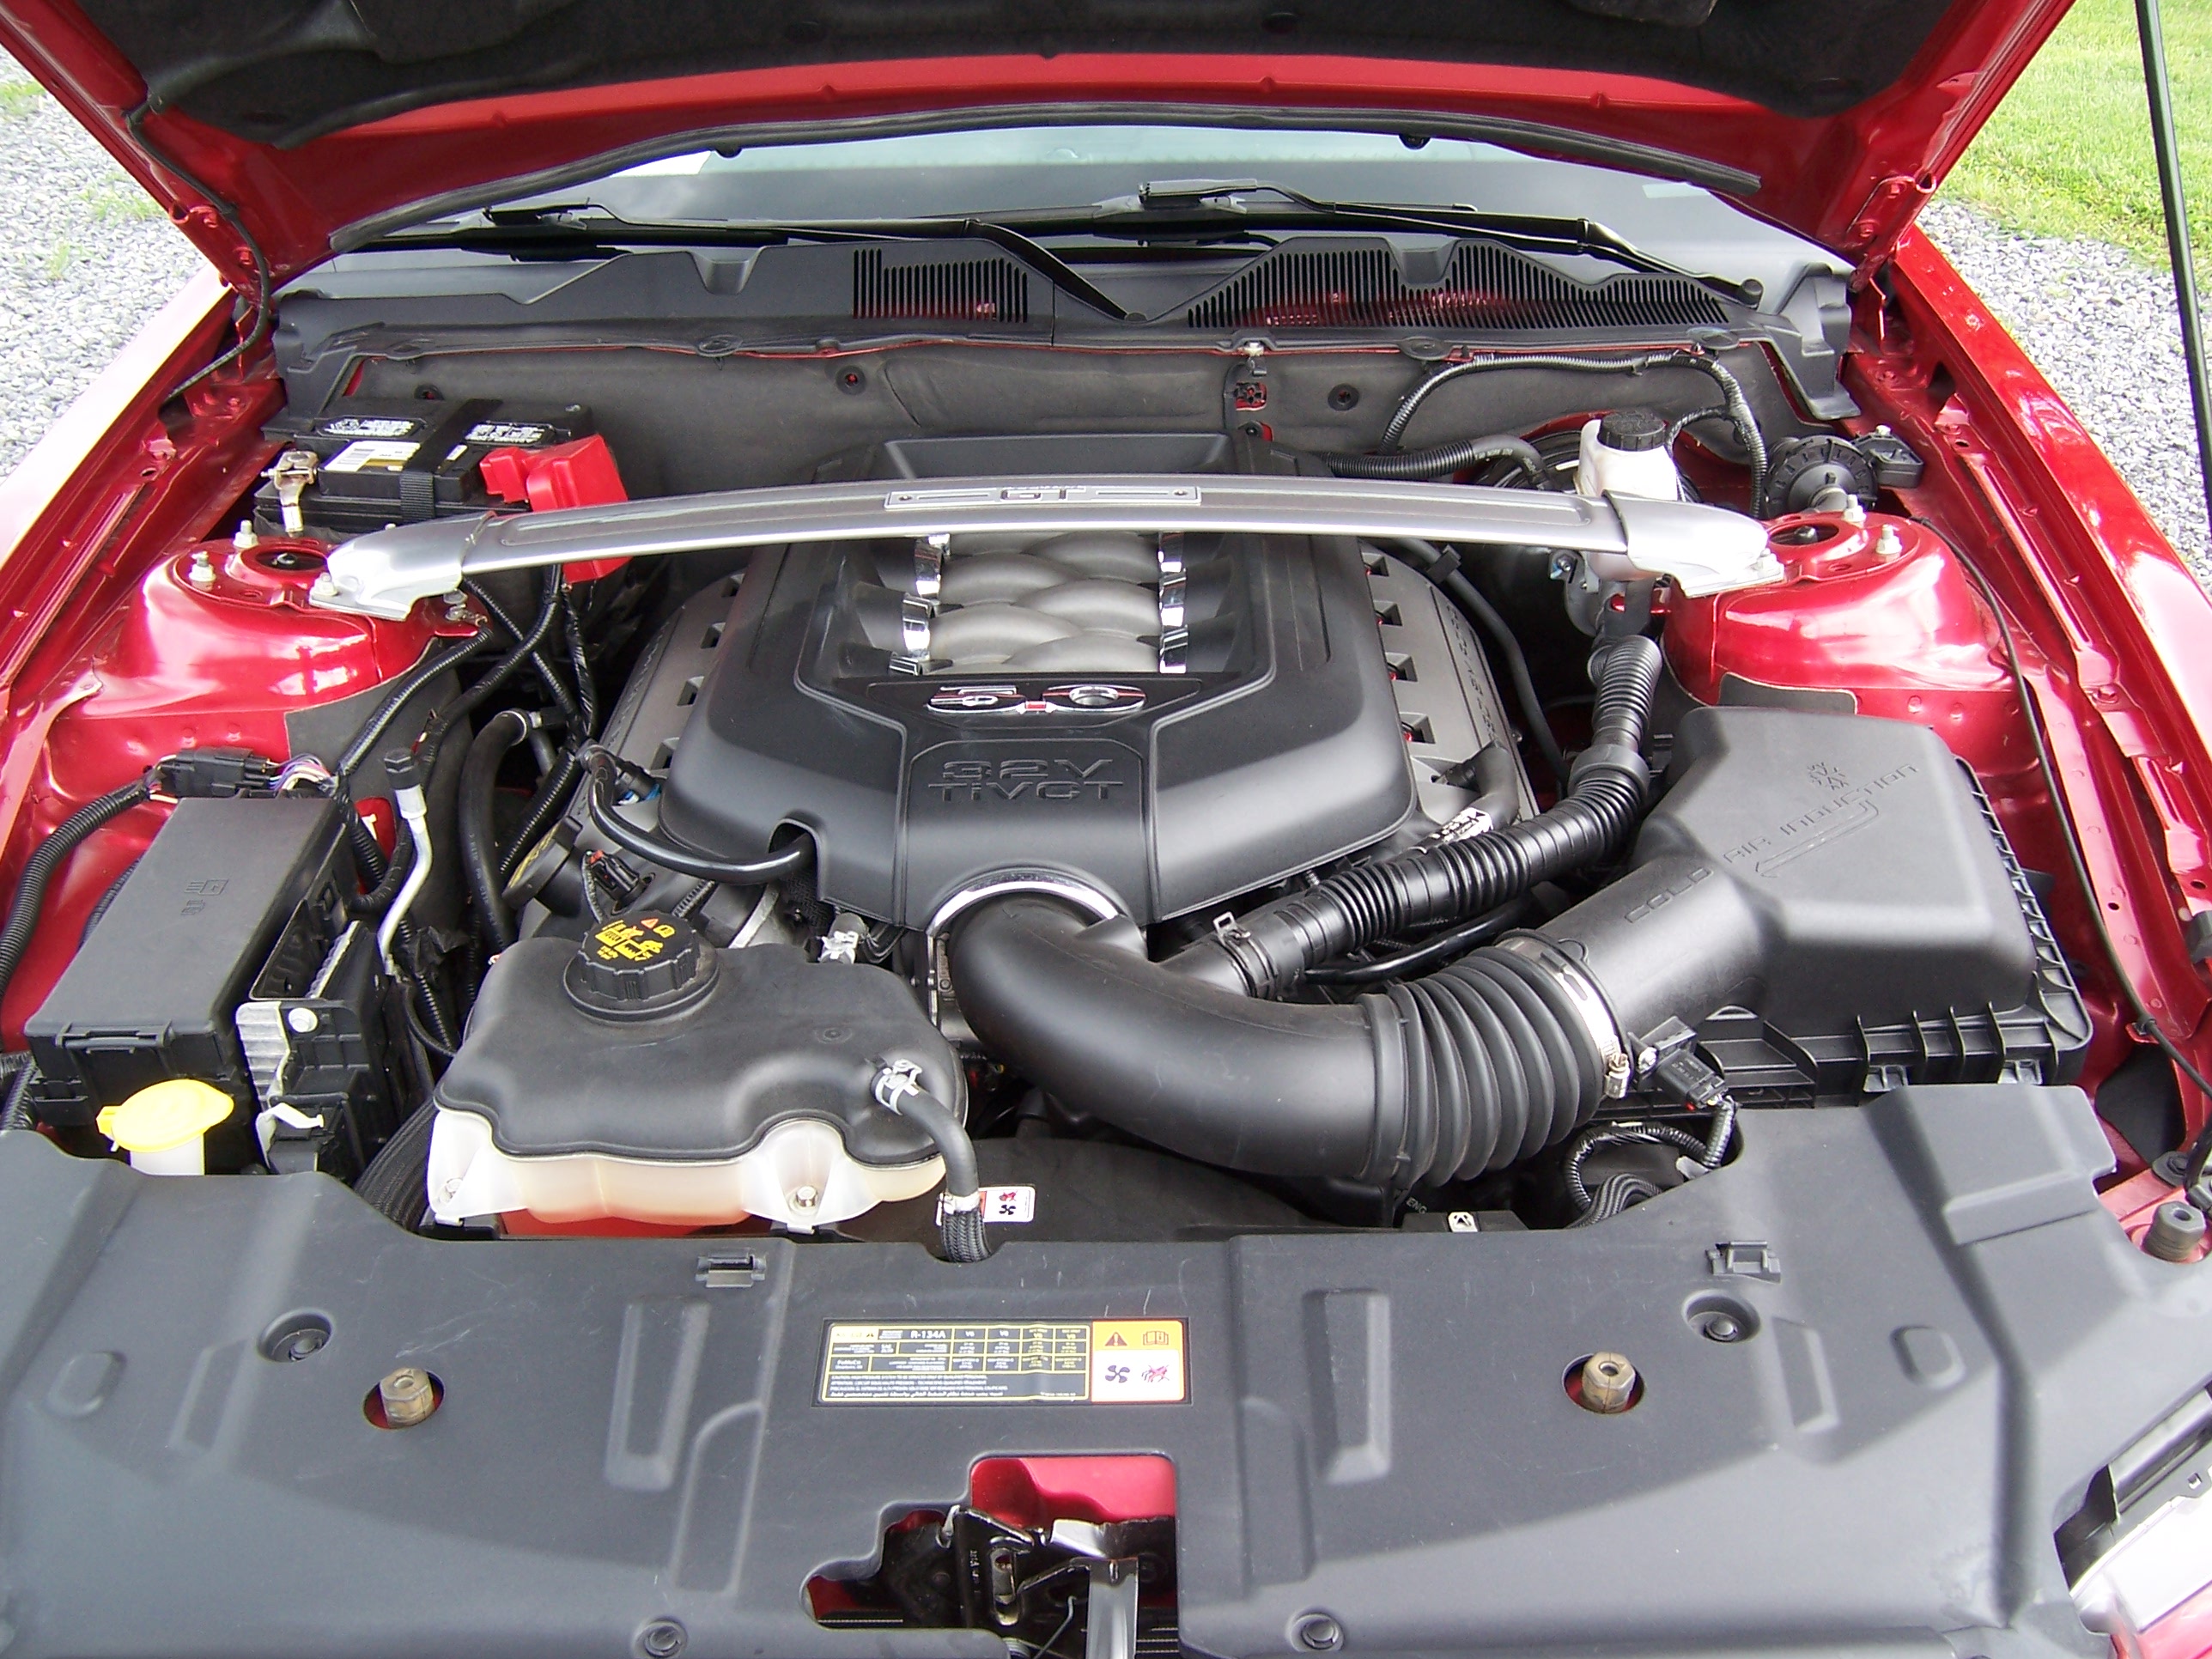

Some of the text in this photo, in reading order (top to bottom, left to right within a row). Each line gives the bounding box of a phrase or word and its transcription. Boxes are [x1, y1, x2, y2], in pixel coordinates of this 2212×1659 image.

[927, 684, 1147, 715] 5.0
[942, 758, 1113, 780] 32V
[1625, 763, 1919, 923] COLD AIR INDUCTION
[1406, 1196, 1428, 1214] ENG
[910, 1329, 946, 1339] R-134A
